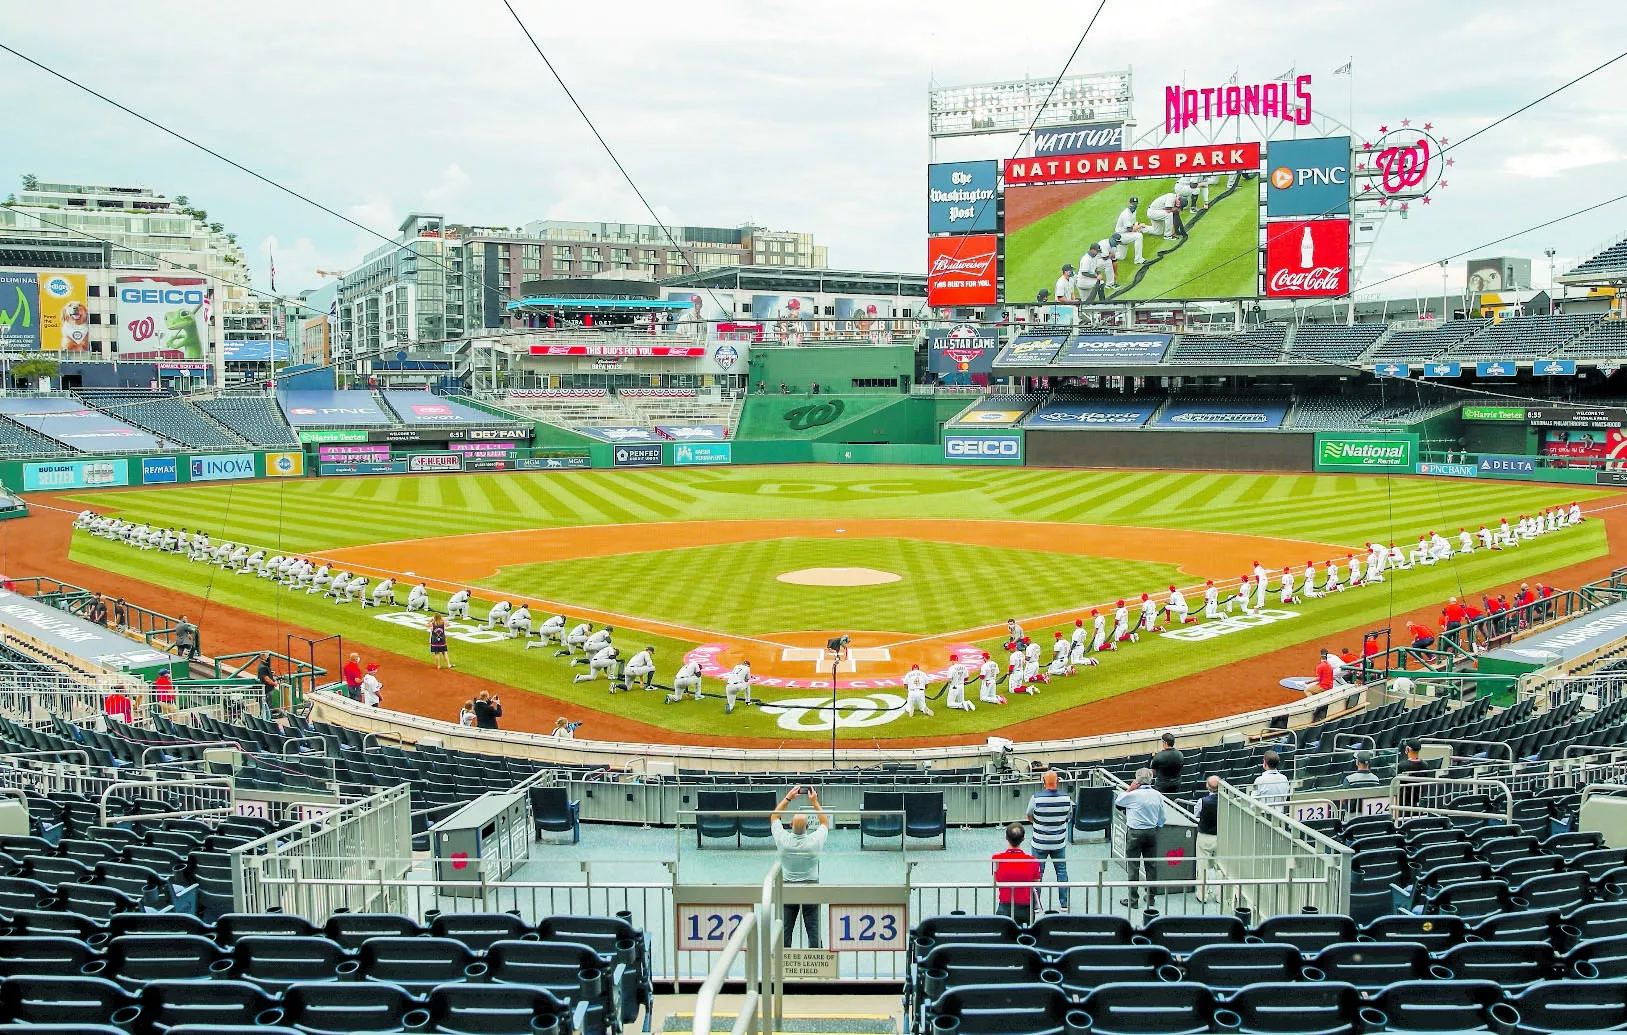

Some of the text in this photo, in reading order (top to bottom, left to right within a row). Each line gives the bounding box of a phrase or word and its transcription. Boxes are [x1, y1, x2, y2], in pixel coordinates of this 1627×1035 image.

[1165, 74, 1312, 134] NATIONALS
[1035, 126, 1123, 154] NATITUDE
[1012, 149, 1244, 179] NATIONALS PARK
[951, 171, 973, 186] The
[1296, 166, 1346, 187] PNC
[930, 188, 995, 204] Washington
[949, 206, 975, 222] Post
[934, 259, 989, 271] Budweiser
[947, 280, 965, 288] BUD'S
[965, 280, 977, 288] FOR
[1271, 267, 1345, 292] Coca-Cola
[121, 288, 203, 305] GEICO
[585, 346, 655, 355] THIS BUD'S FOR YOU.
[972, 338, 995, 349] GAME
[1498, 411, 1523, 419] Teeter
[311, 433, 366, 441] Harris Teeter
[500, 430, 526, 438] FAN
[947, 440, 1018, 456] GEICO
[54, 465, 75, 473] LIGHT
[145, 464, 175, 474] RE/MAX
[207, 459, 253, 475] INOVA
[1493, 460, 1533, 471] DELTA
[238, 804, 264, 819] 121
[1297, 806, 1325, 822] 123
[838, 914, 898, 941] 123
